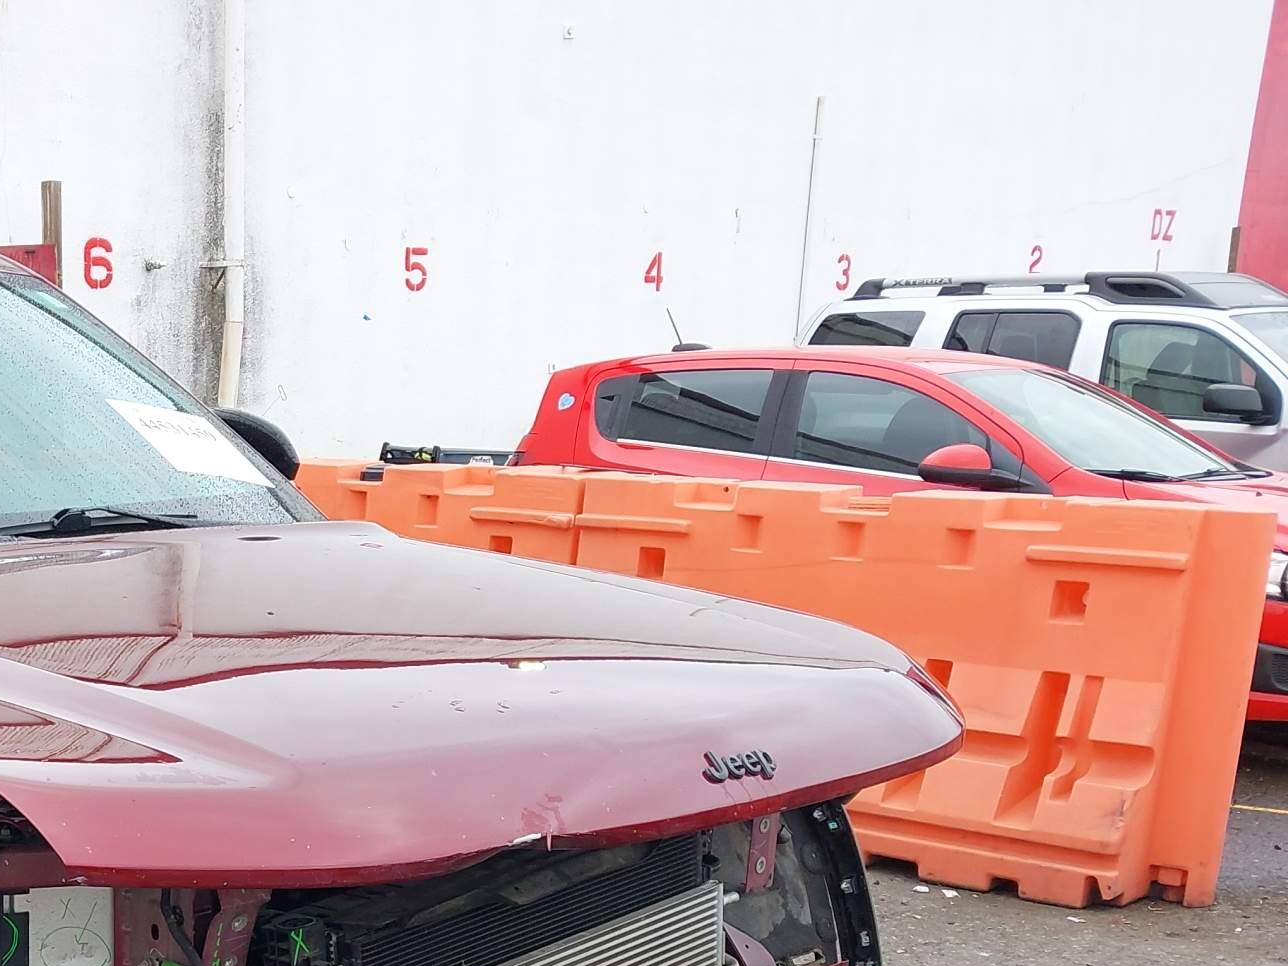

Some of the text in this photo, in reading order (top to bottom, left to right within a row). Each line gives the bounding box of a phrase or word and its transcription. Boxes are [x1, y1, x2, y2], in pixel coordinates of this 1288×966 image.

[1150, 208, 1177, 241] DZ
[83, 236, 114, 290] 6
[405, 246, 429, 292] 5
[644, 252, 665, 291] 4
[835, 254, 852, 291] 3
[1029, 244, 1043, 274] 2
[702, 750, 777, 784] Jeep
